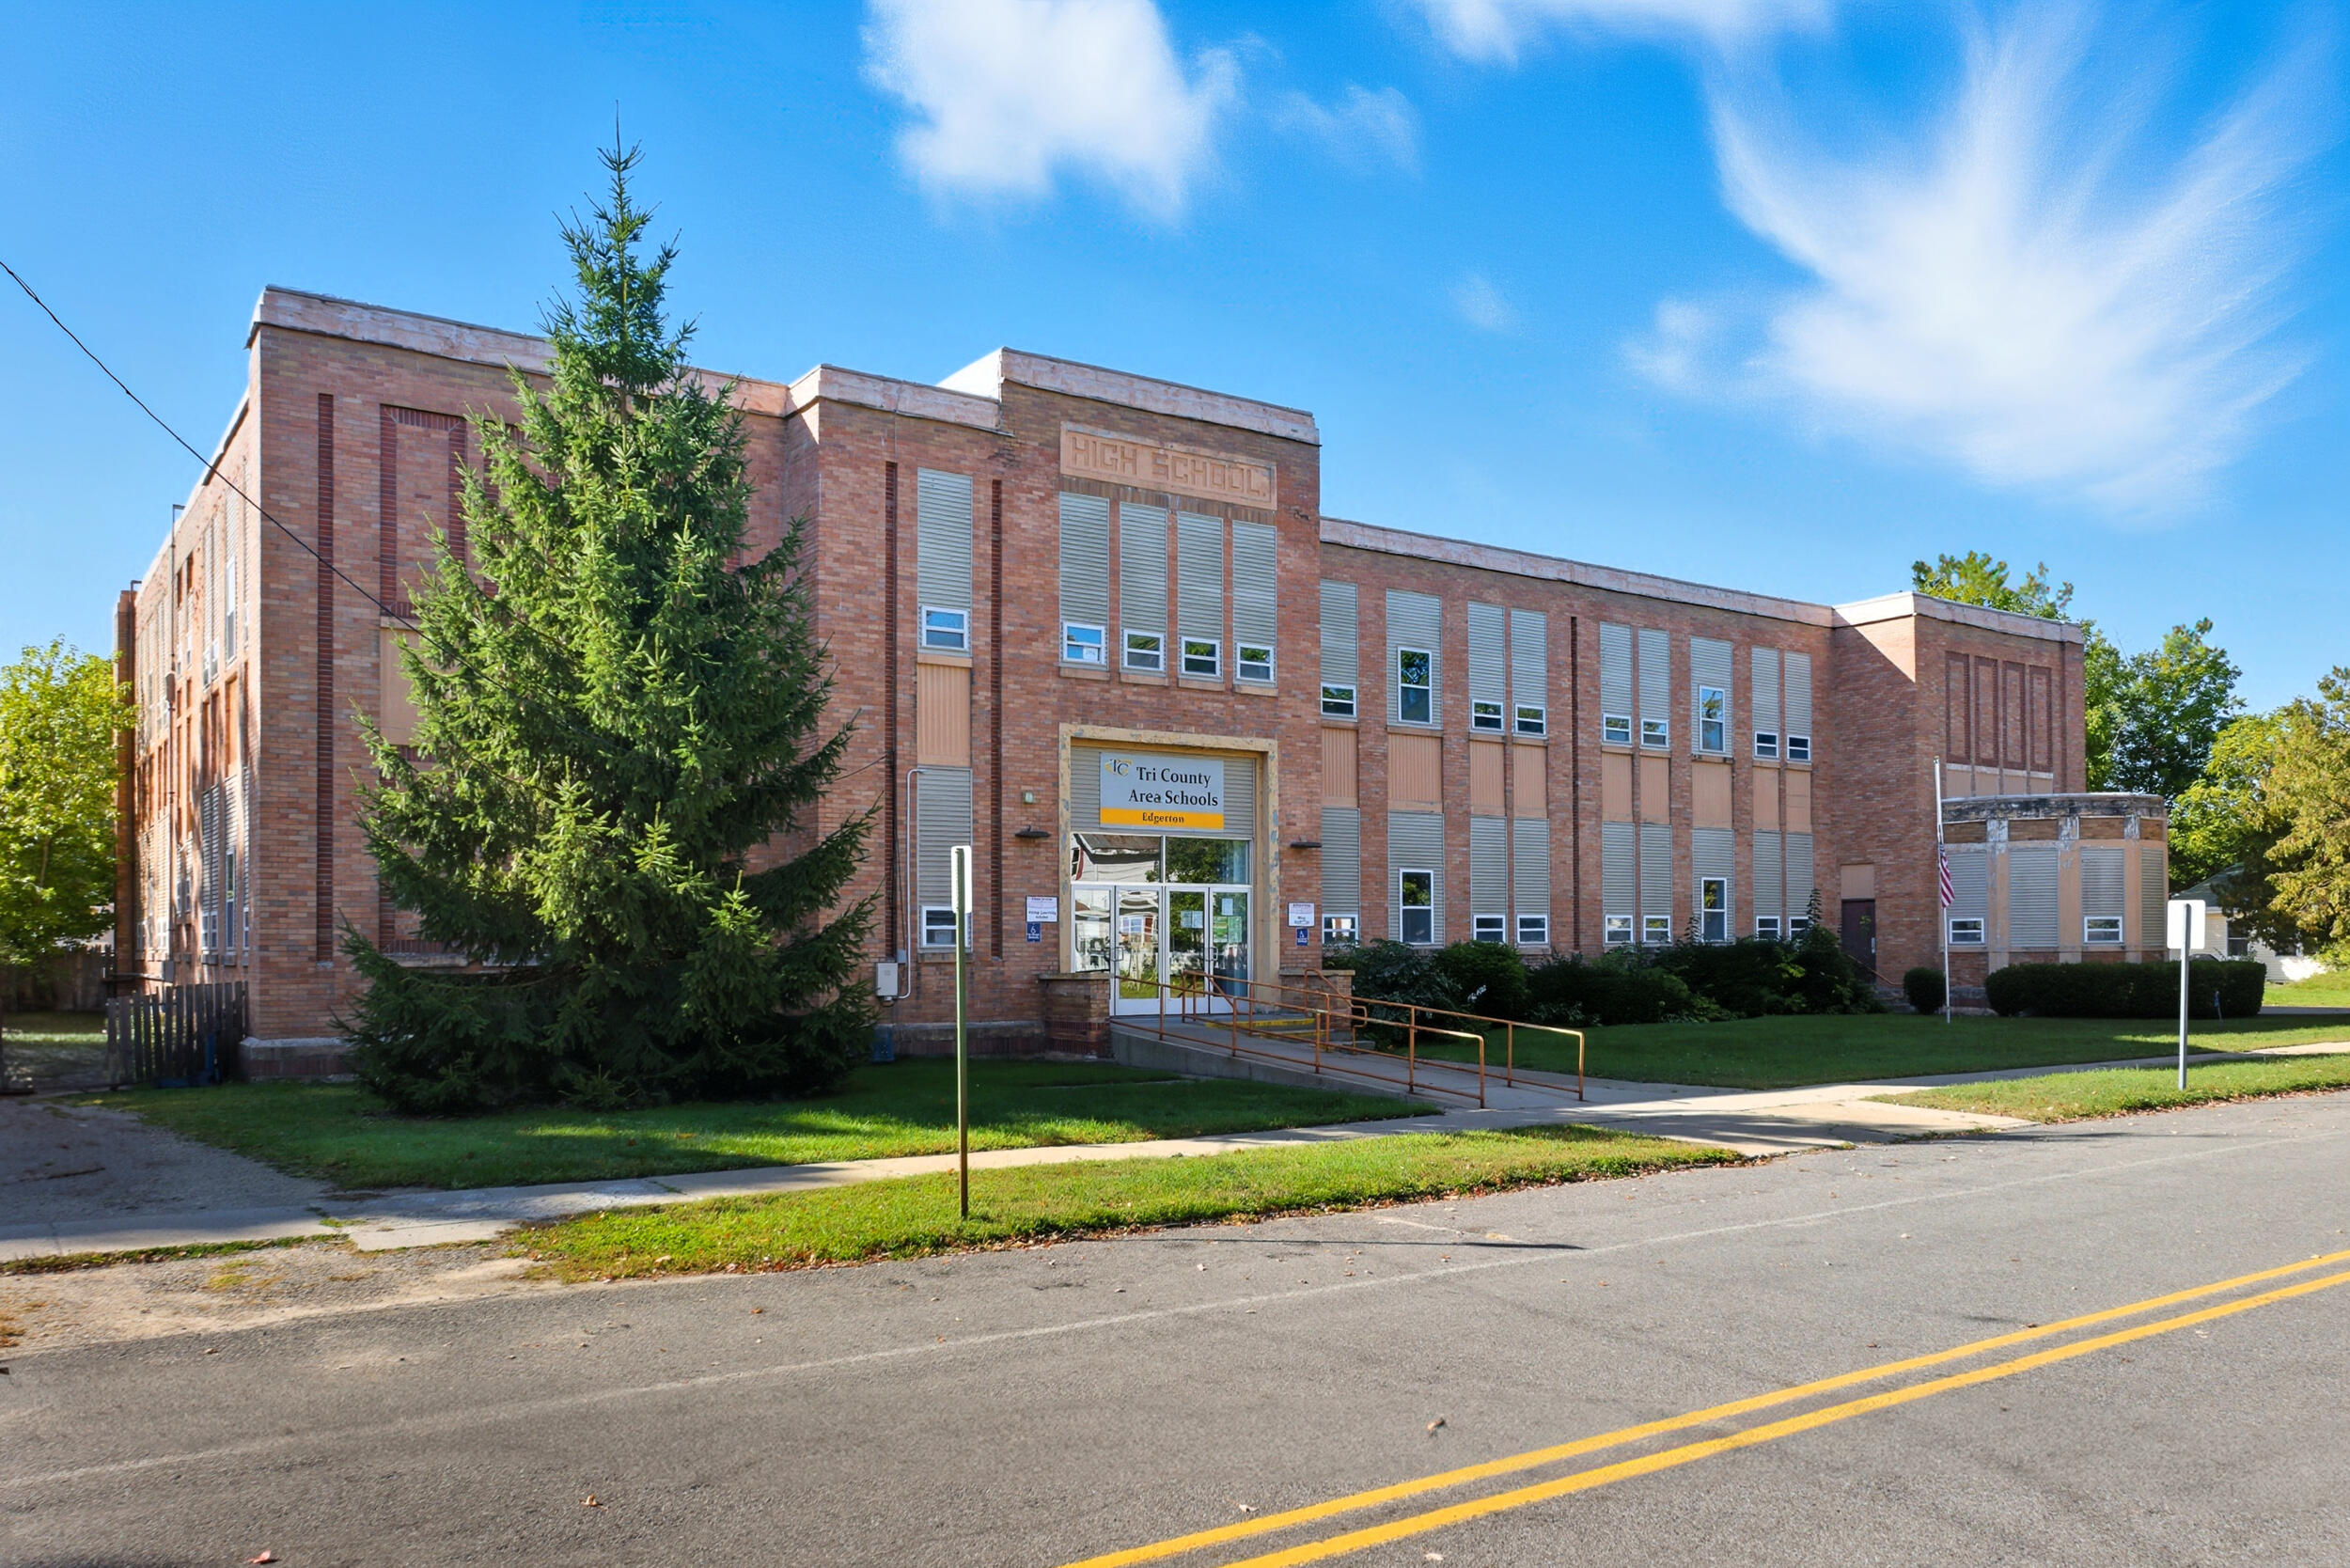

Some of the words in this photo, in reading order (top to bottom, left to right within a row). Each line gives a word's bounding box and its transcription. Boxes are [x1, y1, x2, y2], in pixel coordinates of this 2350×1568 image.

[1072, 436, 1137, 476] HIGH
[1136, 766, 1156, 782] Tri
[1161, 768, 1211, 788] County
[1129, 790, 1161, 804] Area
[1165, 790, 1218, 807] Schools
[1142, 812, 1184, 824] Edgerton
